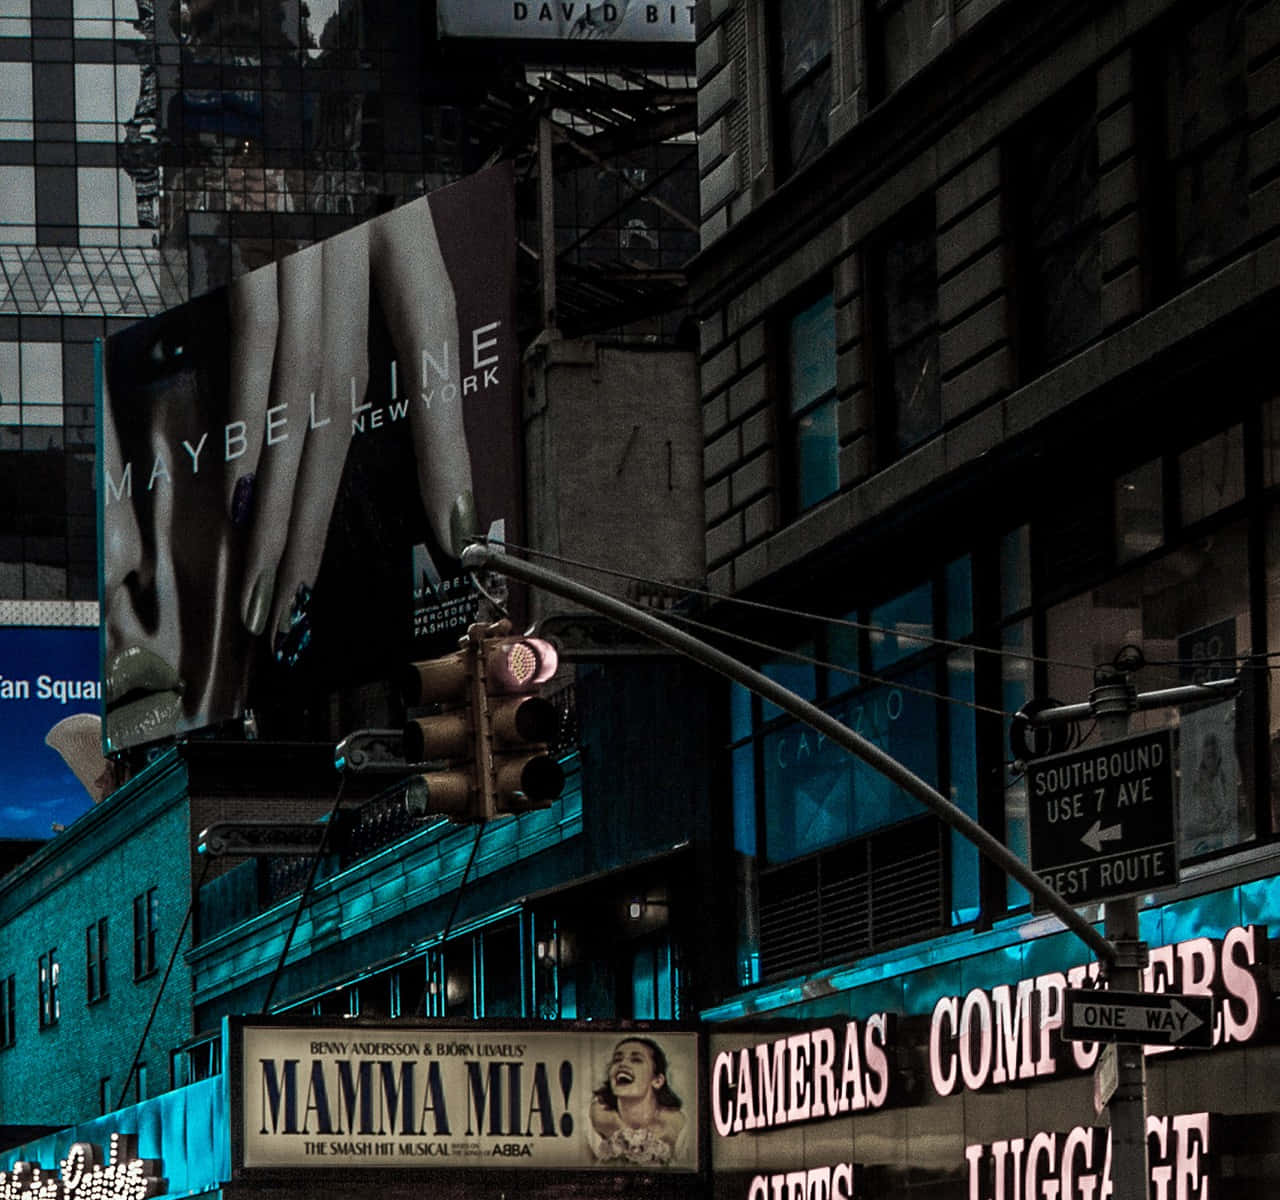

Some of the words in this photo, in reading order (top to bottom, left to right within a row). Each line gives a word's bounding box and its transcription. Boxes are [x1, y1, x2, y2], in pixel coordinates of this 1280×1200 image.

[513, 2, 618, 22] DAVID
[105, 322, 502, 505] MAYBELLINE
[351, 400, 410, 437] NEW
[422, 366, 501, 414] YORK
[1035, 742, 1164, 796] SOUTHBOUND
[1046, 792, 1084, 823] USE
[1094, 786, 1108, 813] 7
[1116, 776, 1153, 809] AVE
[1099, 853, 1165, 888] ROUTE
[1083, 1006, 1127, 1028] ONE
[1145, 1008, 1189, 1032] WAY
[310, 1042, 348, 1056] BENNY
[351, 1042, 421, 1057] ANDERSSON
[423, 1042, 433, 1056] &
[435, 1040, 474, 1057] BJÖRN
[712, 1011, 890, 1137] CAMERAS
[258, 1058, 452, 1136] MAMMA
[464, 1059, 575, 1138] MIA!
[304, 1141, 327, 1156] THE
[330, 1141, 374, 1157] SMASH
[375, 1142, 395, 1157] HIT
[399, 1142, 450, 1157] MUSICAL
[492, 1143, 532, 1158] ABBA
